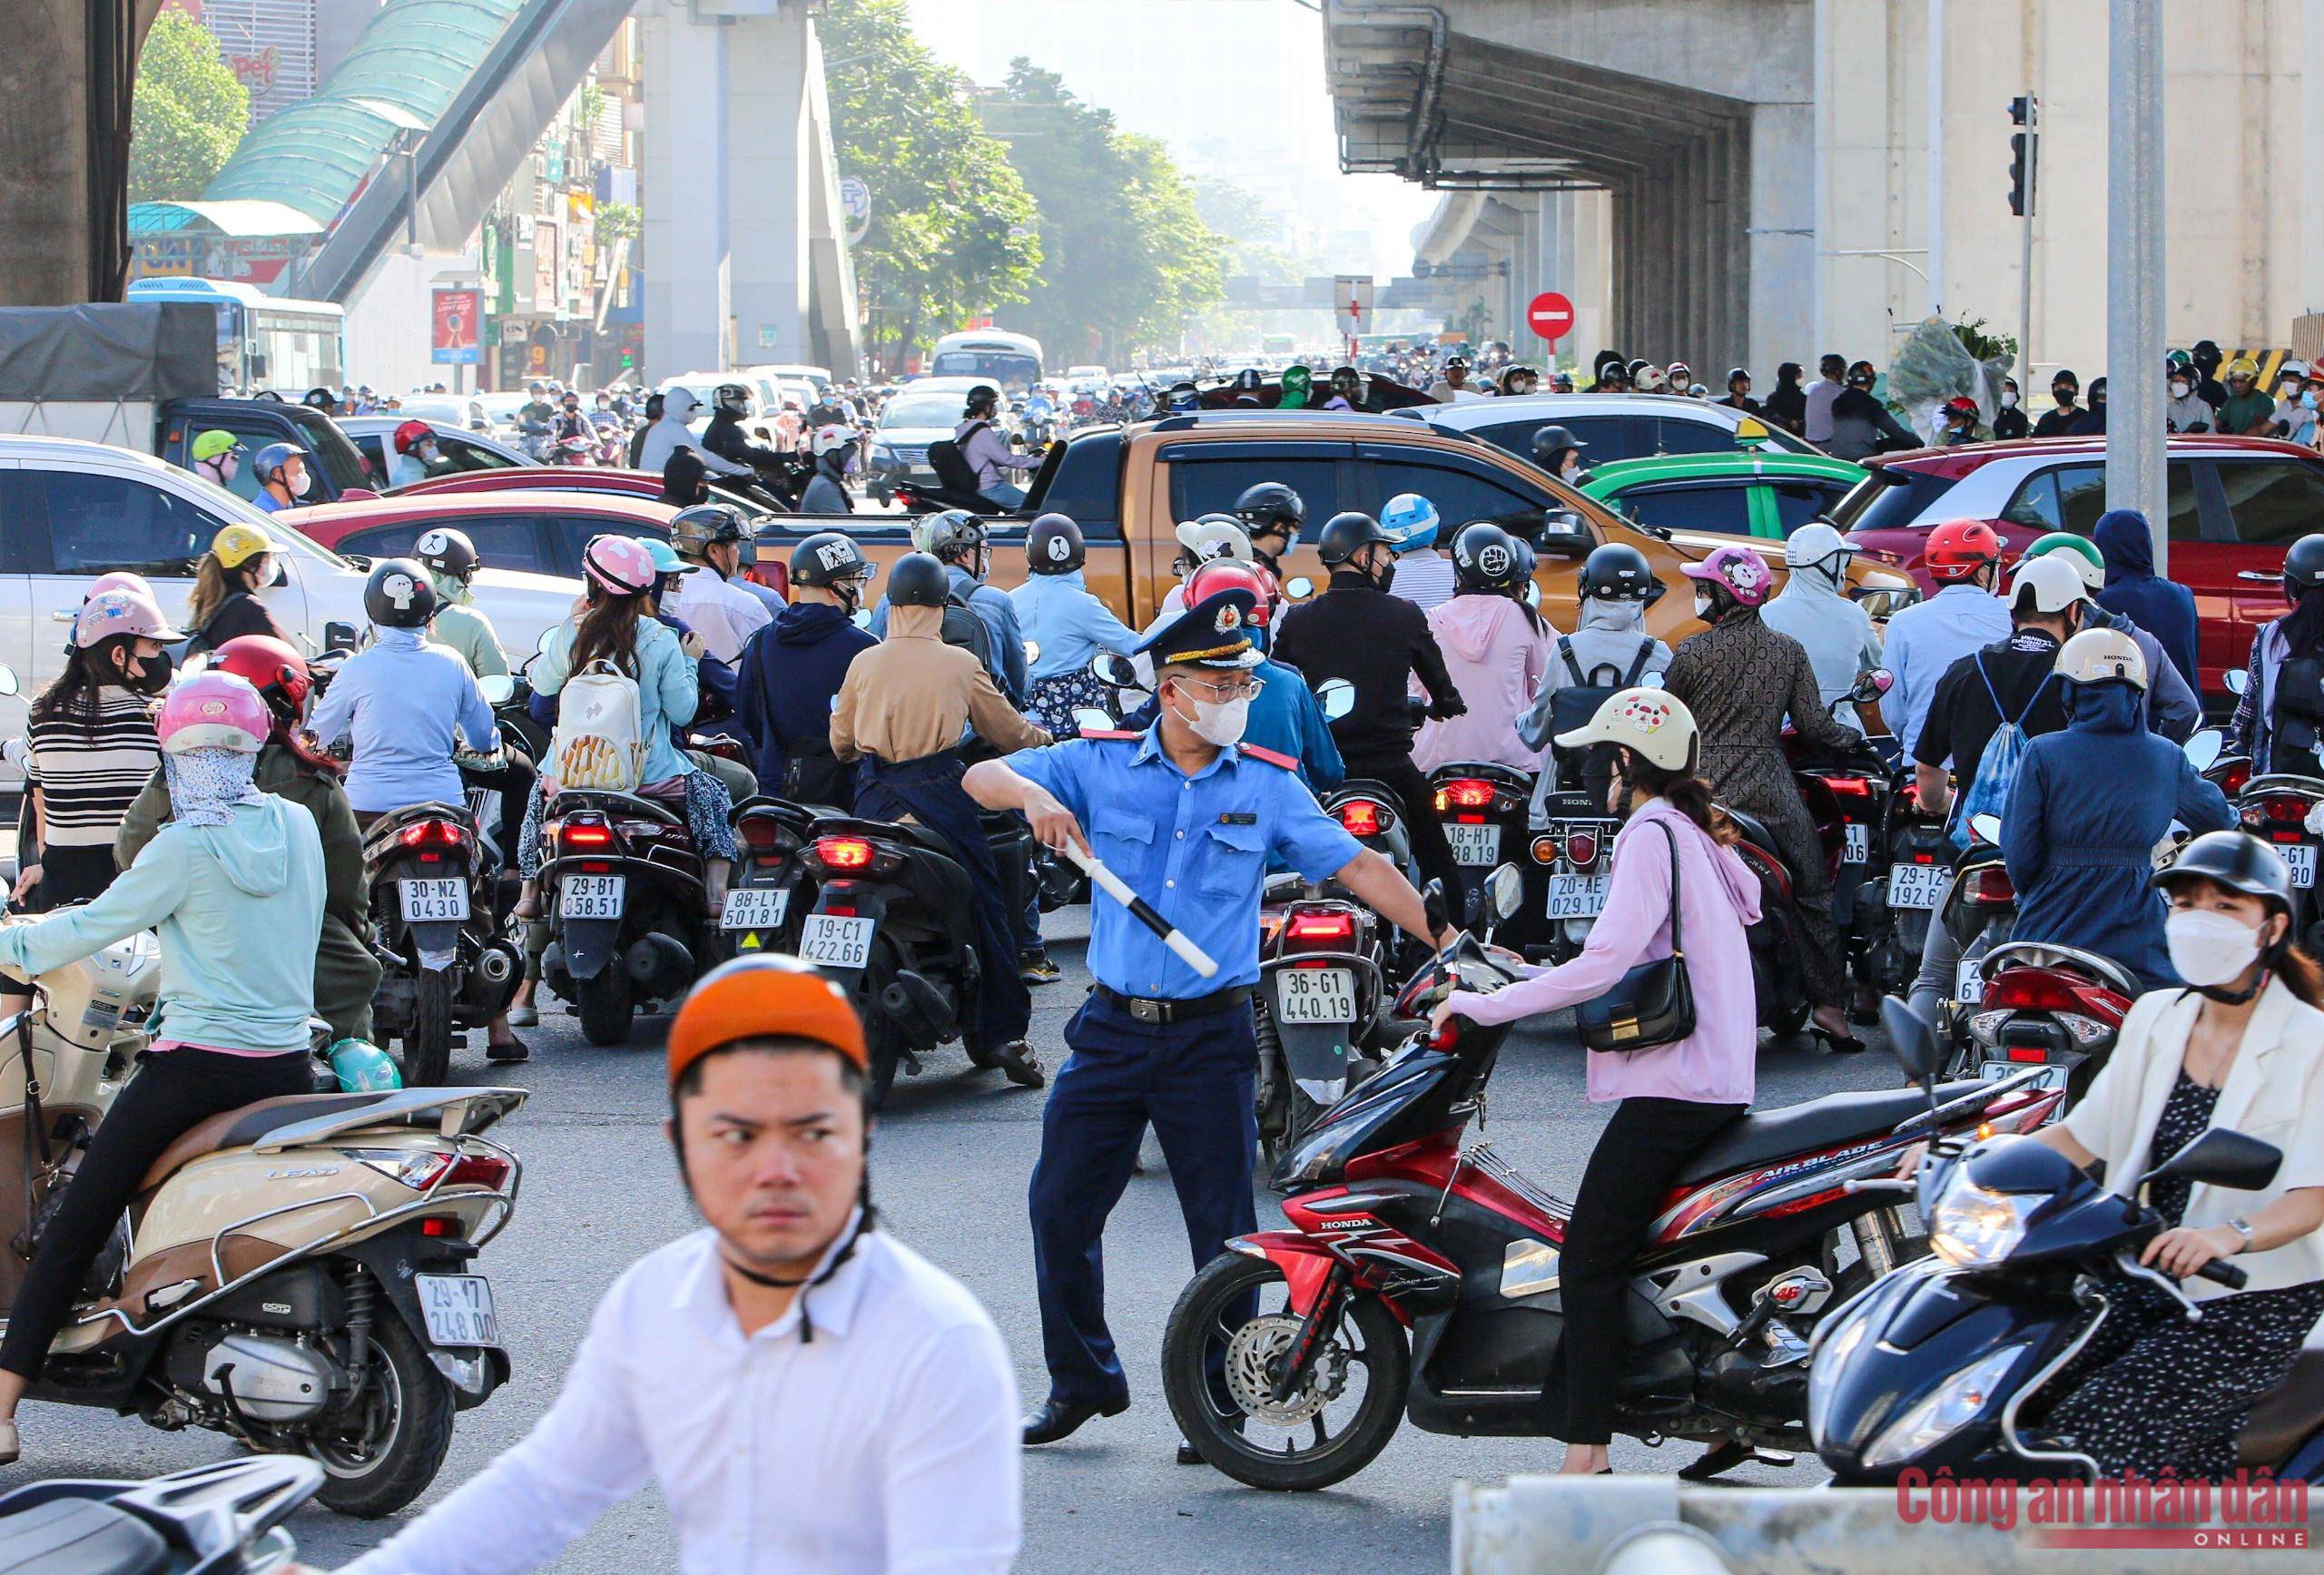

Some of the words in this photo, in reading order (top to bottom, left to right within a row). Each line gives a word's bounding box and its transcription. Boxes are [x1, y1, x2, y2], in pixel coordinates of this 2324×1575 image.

[2102, 654, 2134, 662] HONDA
[1450, 826, 1491, 844] 18-H1
[1899, 866, 1944, 886] 29-T2
[409, 881, 458, 898] 30-N2
[571, 877, 615, 896] 29-B1
[1558, 877, 1602, 895] 20-AE
[565, 898, 617, 916] 858.51
[734, 891, 778, 908] 88-L1
[411, 900, 459, 918] 0430
[724, 909, 781, 926] 501.81
[817, 919, 862, 941] 19-C1
[805, 940, 864, 963] 422.66
[1288, 972, 1340, 994] 36-G1
[1286, 997, 1350, 1019] 440.19
[1756, 1163, 1800, 1181] AIR
[1802, 1140, 1884, 1168] BLADE
[264, 1167, 340, 1180] LEAD
[1320, 1218, 1373, 1230] HONDA
[1773, 1285, 1802, 1302] 46
[430, 1311, 497, 1342] 248.00
